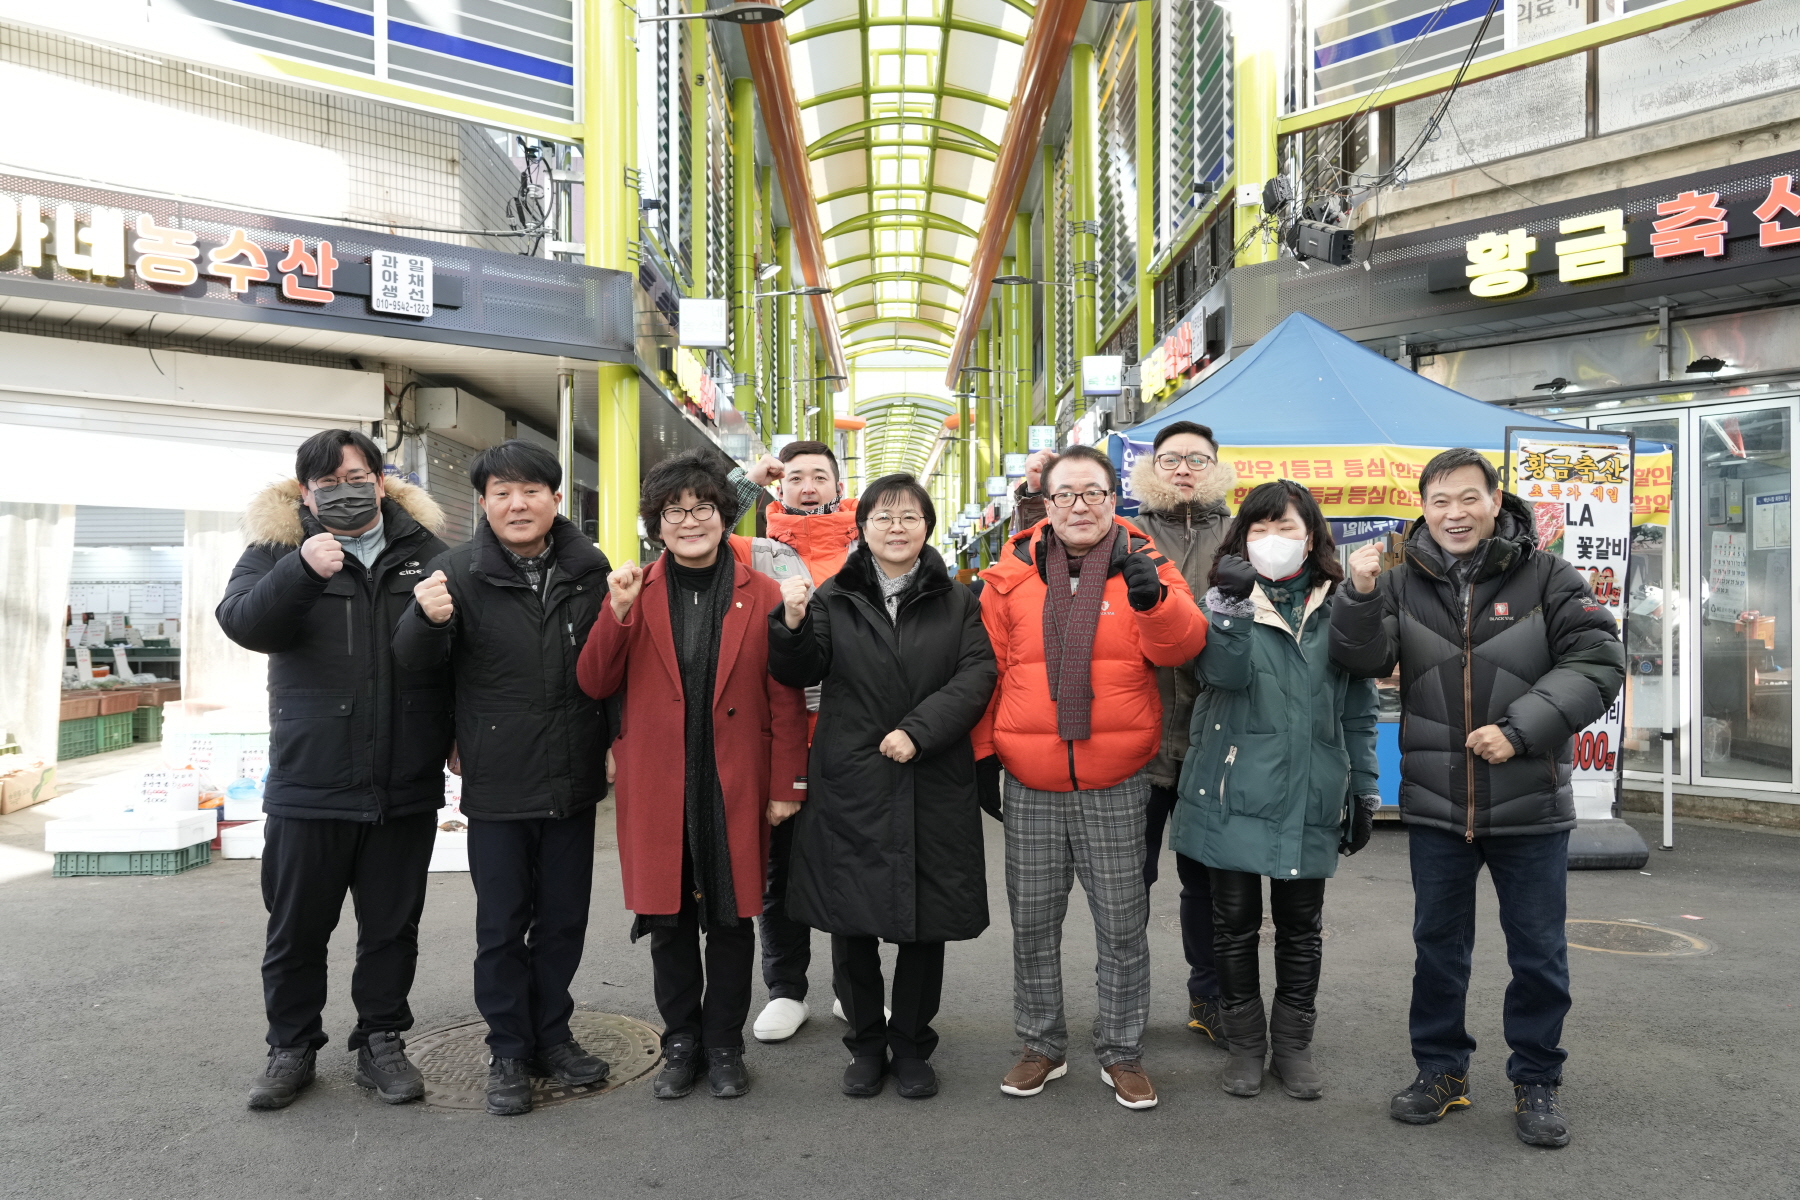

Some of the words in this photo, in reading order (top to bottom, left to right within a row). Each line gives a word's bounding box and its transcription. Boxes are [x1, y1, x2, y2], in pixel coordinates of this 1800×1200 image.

[381, 254, 424, 273] 과일
[381, 270, 424, 288] 야채
[381, 284, 424, 302] 생선
[376, 298, 430, 315] 010-9542-1223
[1233, 460, 1275, 480] 한우
[1280, 459, 1333, 479] 1등급
[1344, 458, 1386, 478] 등심
[1634, 466, 1671, 487] 할인
[1524, 453, 1624, 483] 황금축산
[1347, 485, 1388, 505] 등심
[1590, 486, 1618, 503] 세일
[1577, 536, 1627, 560] 꽃갈비
